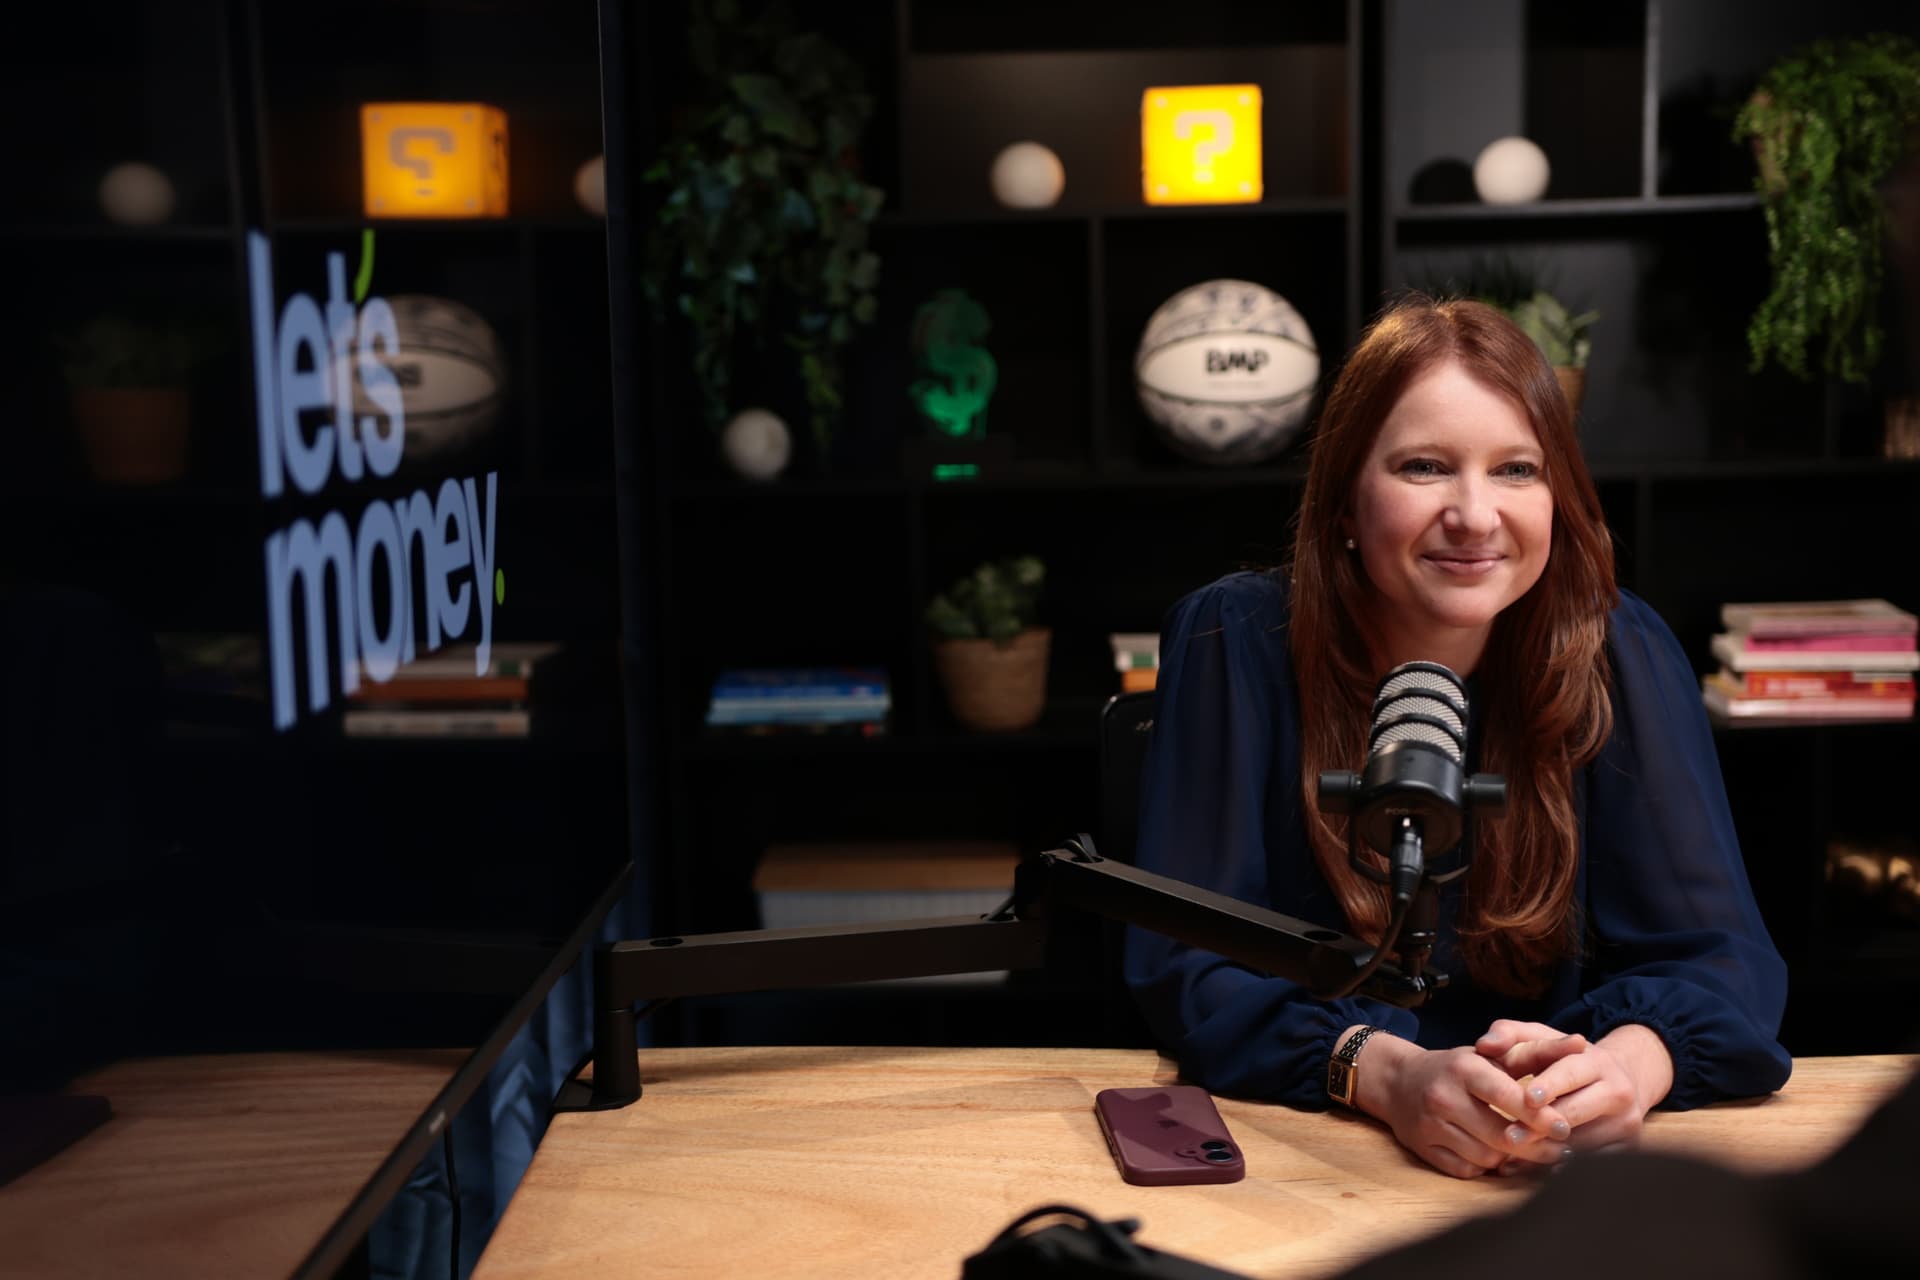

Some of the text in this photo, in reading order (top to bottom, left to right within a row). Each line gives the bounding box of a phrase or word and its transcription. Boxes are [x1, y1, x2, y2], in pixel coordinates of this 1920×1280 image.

[247, 228, 406, 498] let's
[1206, 350, 1270, 373] BMP
[264, 471, 505, 733] money.
